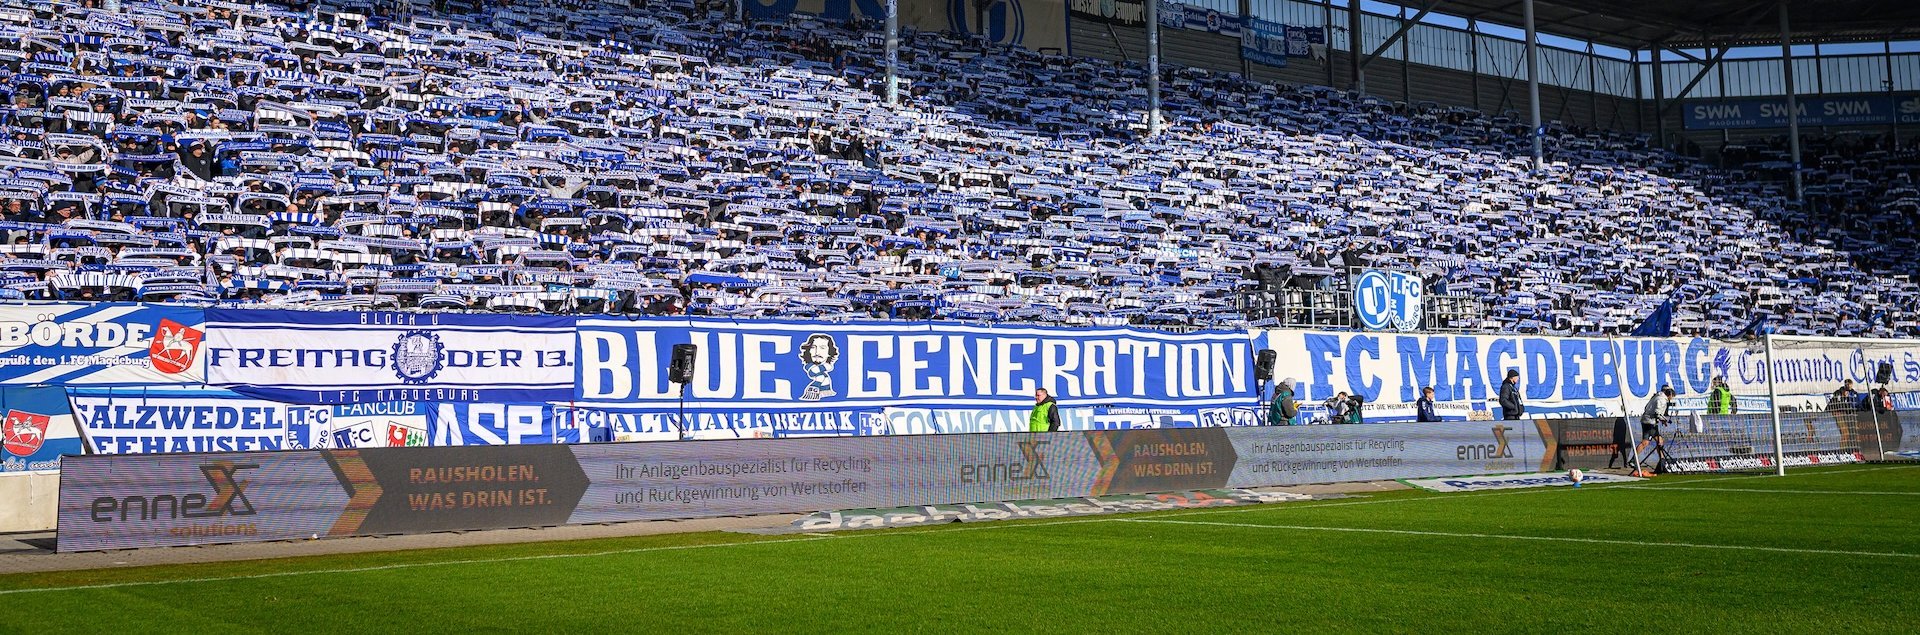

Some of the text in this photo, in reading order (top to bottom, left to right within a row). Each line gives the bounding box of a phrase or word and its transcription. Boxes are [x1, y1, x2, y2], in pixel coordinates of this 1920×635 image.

[1694, 104, 1741, 120] SWM
[1760, 103, 1807, 118] SWM
[1823, 100, 1872, 116] SWM
[1392, 275, 1420, 298] 1.FC
[360, 313, 439, 325] BLOCK U
[0, 312, 152, 349] BÖRDE
[0, 355, 31, 368] grüßt
[33, 355, 56, 366] den
[88, 355, 151, 369] Magdeburg
[209, 347, 388, 371] FREITAG
[446, 349, 523, 368] DER
[535, 349, 574, 368] 13.
[578, 330, 1247, 400] BLUE GENERATION
[1738, 349, 1844, 385] Commando
[1396, 335, 1712, 402] MAGDEBURG
[377, 389, 480, 401] MAGDEBURG
[340, 401, 416, 416] FANCLUB
[1386, 402, 1409, 410] HEIMAT
[78, 404, 283, 430] SALZWEDEL
[99, 435, 284, 452] EEHAUSEN
[1133, 442, 1209, 459] RAUSHOLEN,
[1252, 442, 1264, 454] Ihr
[1266, 438, 1353, 455] Anlagenbauspezialist
[1369, 436, 1405, 451] Recycling
[1566, 445, 1585, 457] WAS
[1586, 444, 1606, 456] DRIN
[616, 463, 634, 480] Ihr
[639, 458, 787, 480] Anlagenbauspezialist
[812, 455, 872, 473] Recycling
[1133, 460, 1217, 478] WAS DRIN IST.
[1252, 461, 1269, 473] und
[1339, 458, 1354, 469] von
[1356, 455, 1403, 468] Wertstoffen
[409, 464, 540, 483] RAUSHOLEN,
[408, 487, 552, 512] WAS DRIN IST.
[615, 487, 644, 504] und
[763, 484, 788, 498] von
[791, 478, 868, 496] Wertstoffen
